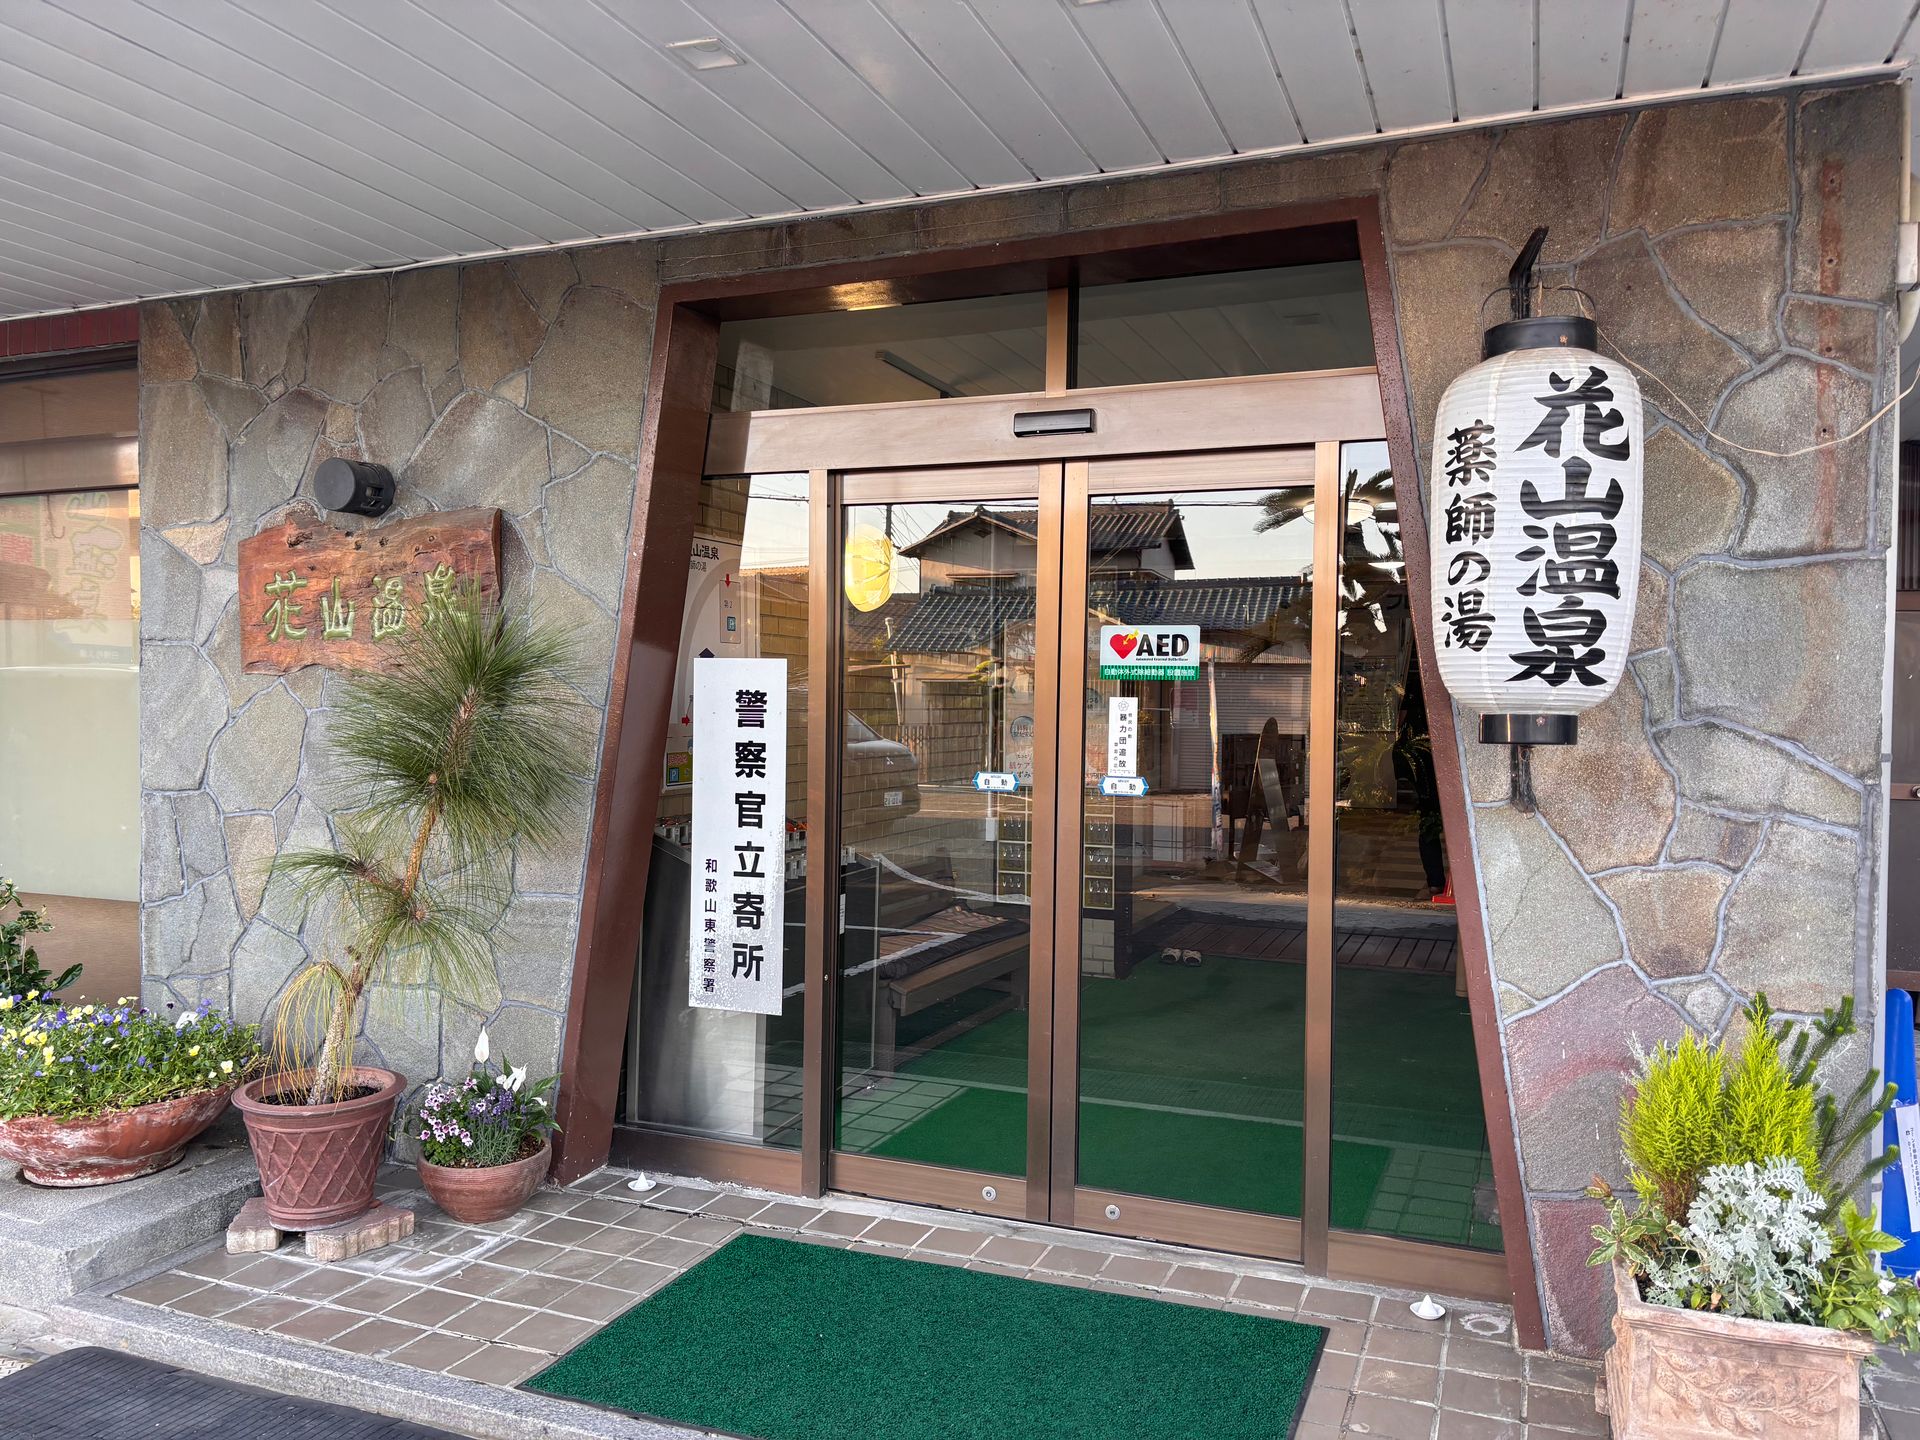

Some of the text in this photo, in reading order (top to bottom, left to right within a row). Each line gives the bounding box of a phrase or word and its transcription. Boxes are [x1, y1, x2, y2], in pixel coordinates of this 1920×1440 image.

[691, 544, 719, 560] 山温泉
[1441, 419, 1498, 652] 薬師の湯
[1504, 365, 1631, 687] 花山温泉
[1136, 634, 1189, 656] AED
[1118, 713, 1127, 768] 暴力団追放
[984, 778, 1008, 787] 自動
[1110, 783, 1136, 791] 自動
[731, 689, 768, 982] 警察官立寄所
[702, 858, 718, 993] 和歌山東警察署
